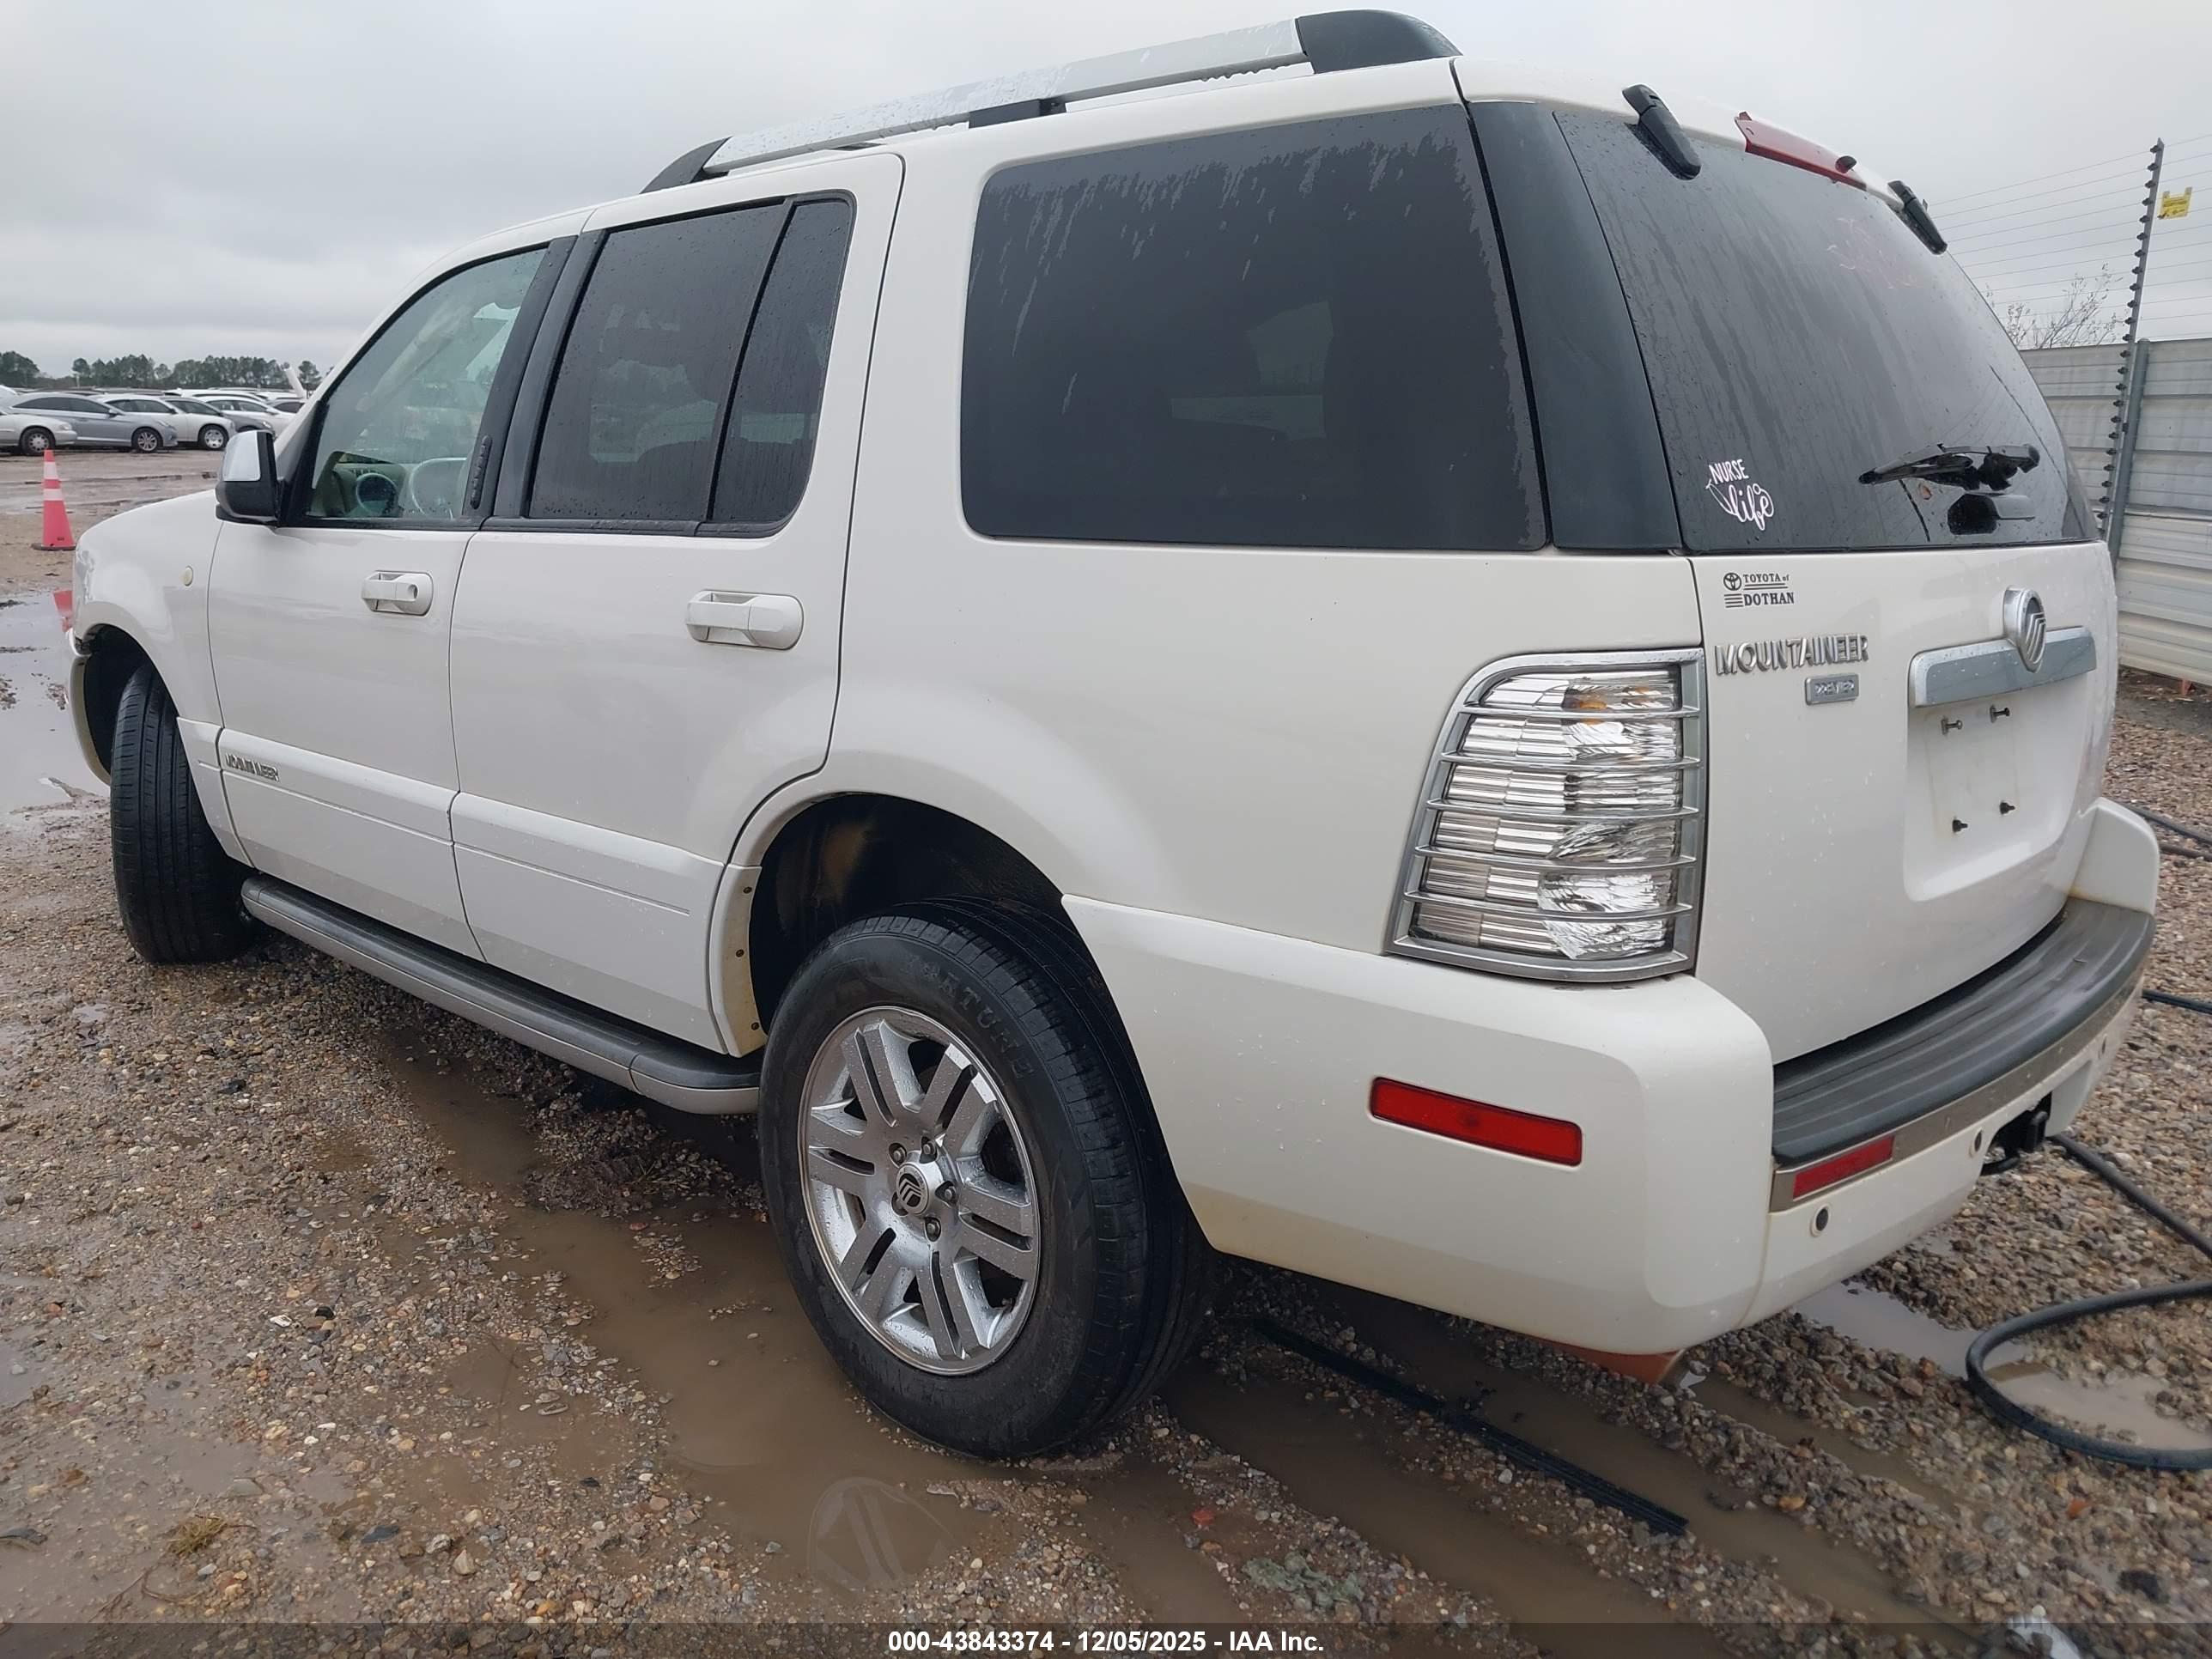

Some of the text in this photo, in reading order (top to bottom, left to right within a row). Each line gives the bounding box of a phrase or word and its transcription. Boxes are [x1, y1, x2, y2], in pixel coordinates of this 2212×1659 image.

[1709, 459, 1749, 484] NURSE
[1743, 573, 1781, 583] TOYOTA
[1743, 592, 1795, 606] DOTHAN
[1715, 634, 1869, 675] MOUNTAINEER
